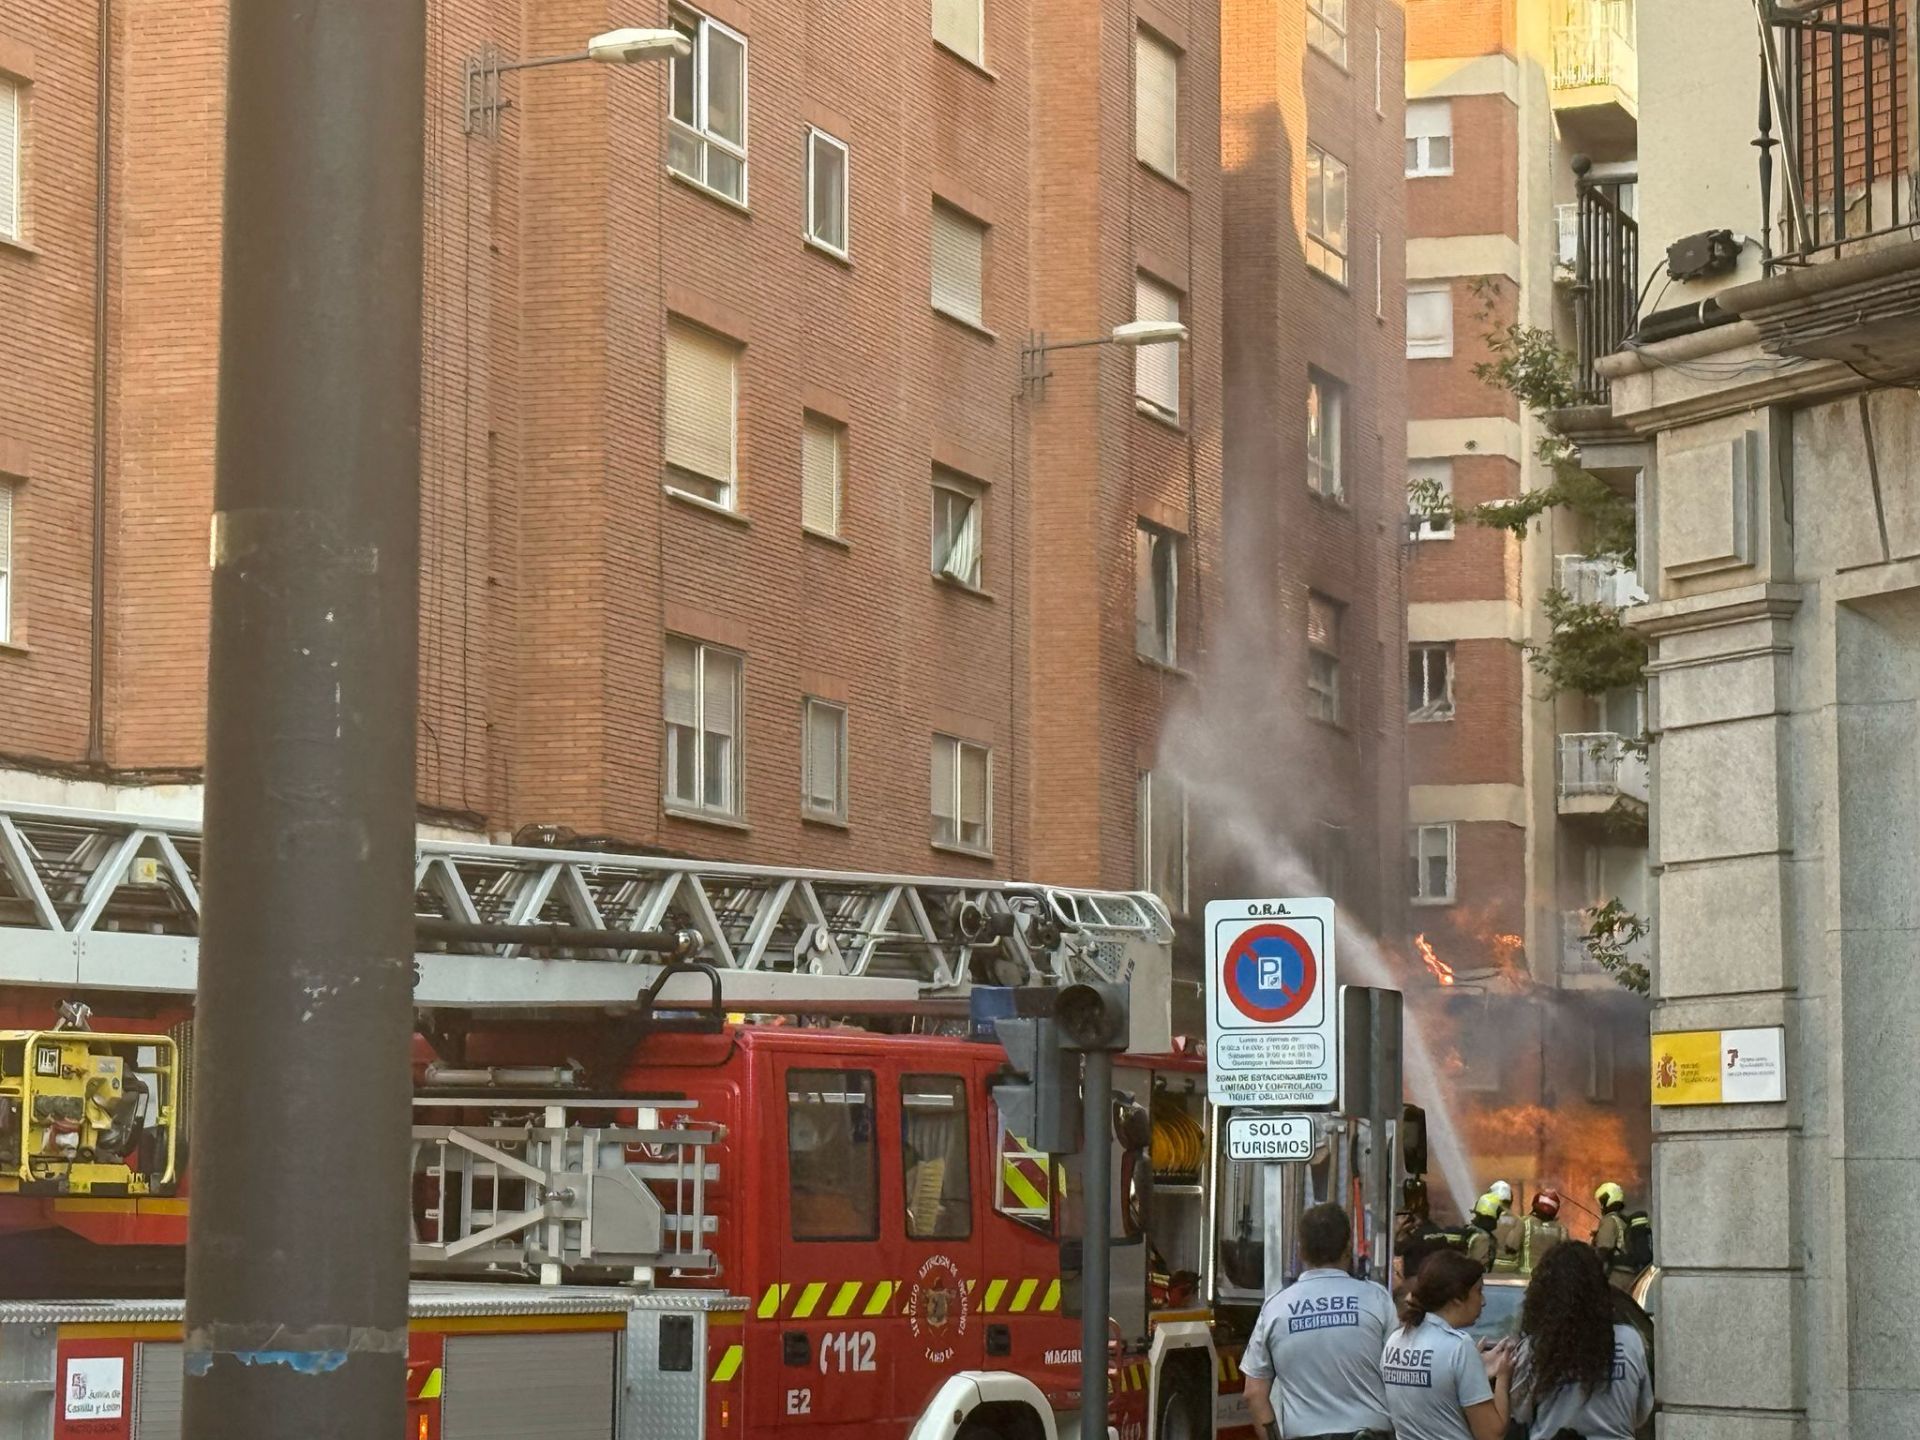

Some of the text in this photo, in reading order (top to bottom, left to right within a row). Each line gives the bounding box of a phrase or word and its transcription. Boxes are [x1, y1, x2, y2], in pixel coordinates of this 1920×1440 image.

[1247, 903, 1292, 916] O.R.A.
[1215, 1074, 1237, 1083] ZONA
[1238, 1073, 1249, 1082] DE
[1220, 1082, 1323, 1091] LIMITADO Y CONTROLADO
[1258, 1092, 1314, 1101] OBLIGATORIO
[1249, 1122, 1293, 1136] SOLO
[1232, 1140, 1309, 1154] TURISMOS
[1287, 1295, 1359, 1316] VASBE
[1290, 1313, 1358, 1334] SEGURIDAD
[833, 1331, 876, 1373] 112
[1385, 1347, 1435, 1368] VASBE
[786, 1387, 812, 1416] E2
[95, 1405, 101, 1415] y
